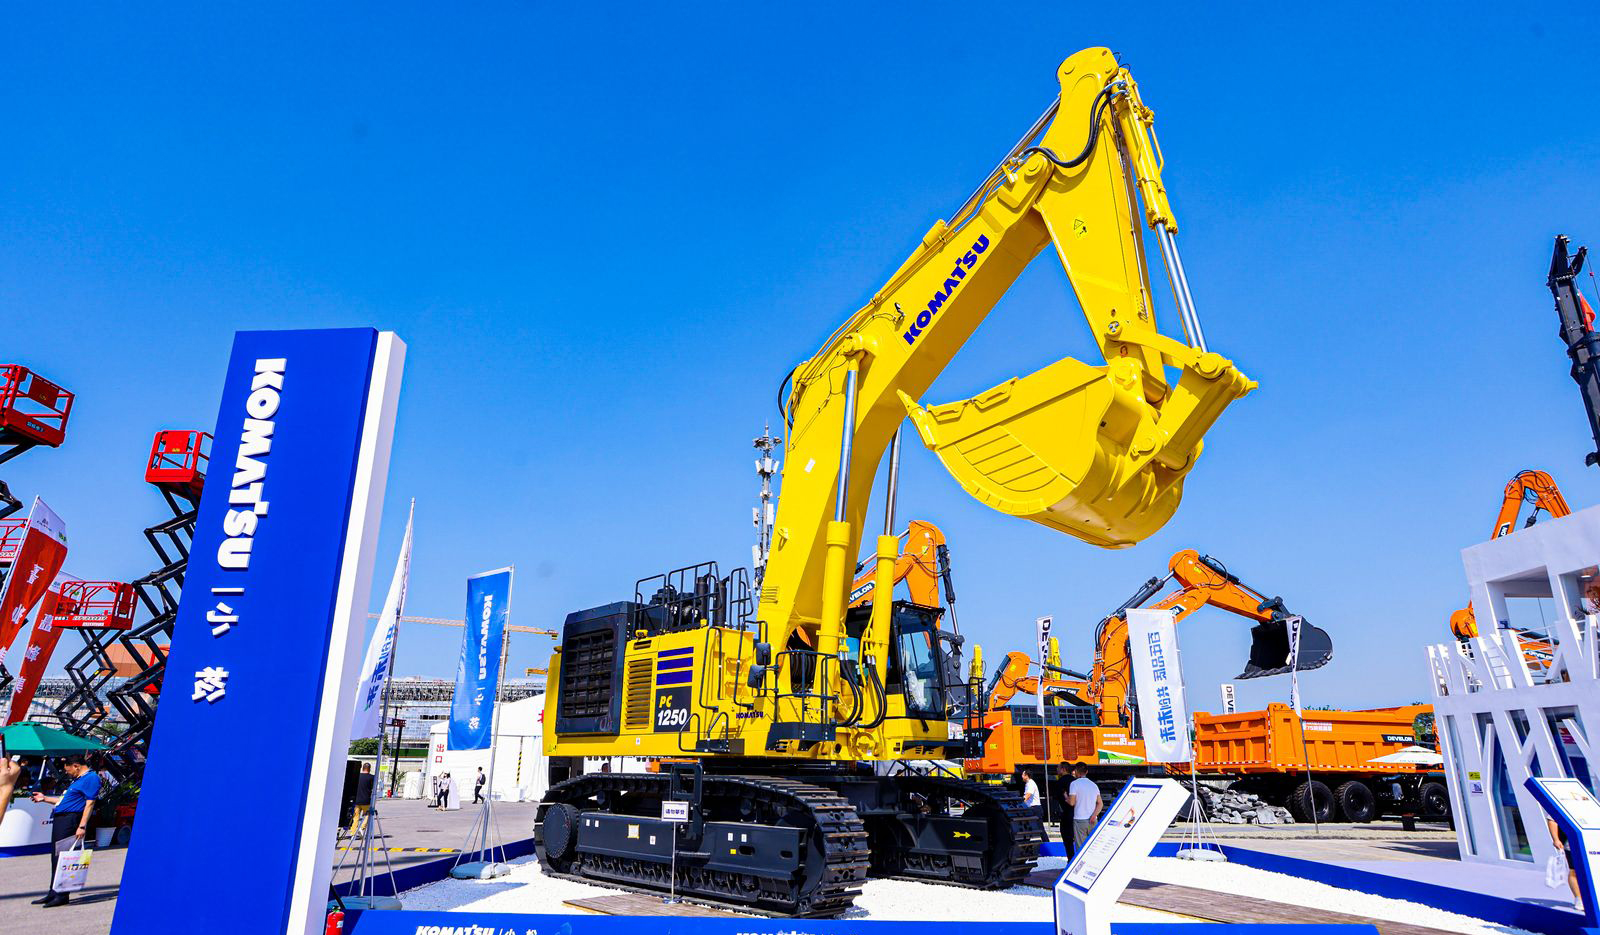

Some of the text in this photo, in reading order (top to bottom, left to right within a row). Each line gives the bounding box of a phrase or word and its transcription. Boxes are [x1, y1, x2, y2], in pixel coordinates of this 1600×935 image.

[903, 233, 990, 345] KOMATSU
[217, 357, 287, 569] KOMATSU
[849, 583, 873, 602] VELON
[658, 695, 673, 708] PC
[657, 708, 687, 726] 1250
[735, 710, 764, 719] KOMATSU
[435, 743, 445, 764] 出口
